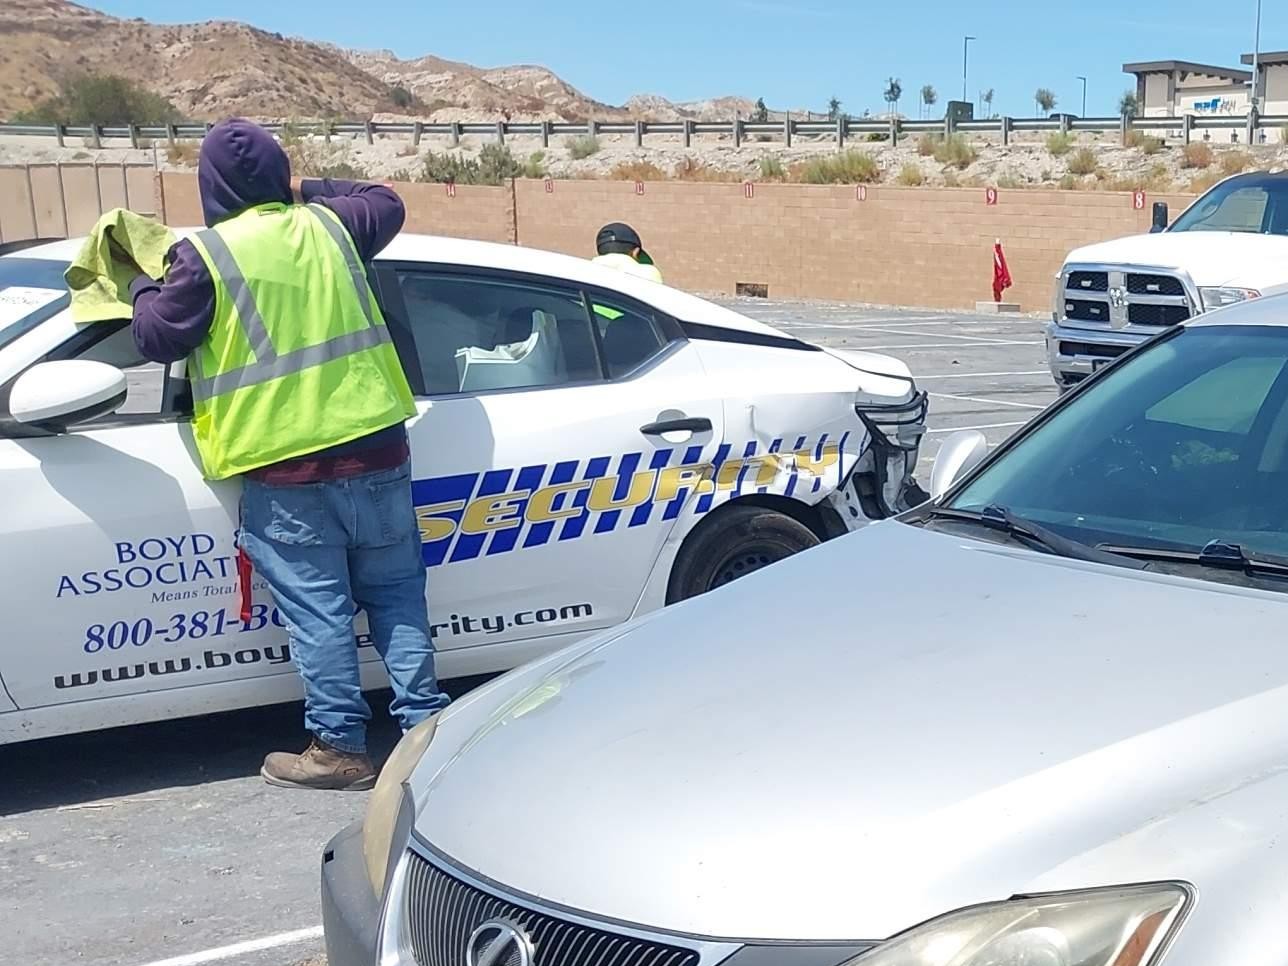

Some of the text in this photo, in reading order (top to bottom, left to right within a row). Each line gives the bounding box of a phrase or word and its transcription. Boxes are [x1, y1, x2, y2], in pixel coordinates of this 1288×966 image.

[1135, 192, 1143, 209] 8
[115, 533, 215, 564] BOYD
[151, 589, 198, 603] Means
[202, 582, 238, 597] Total
